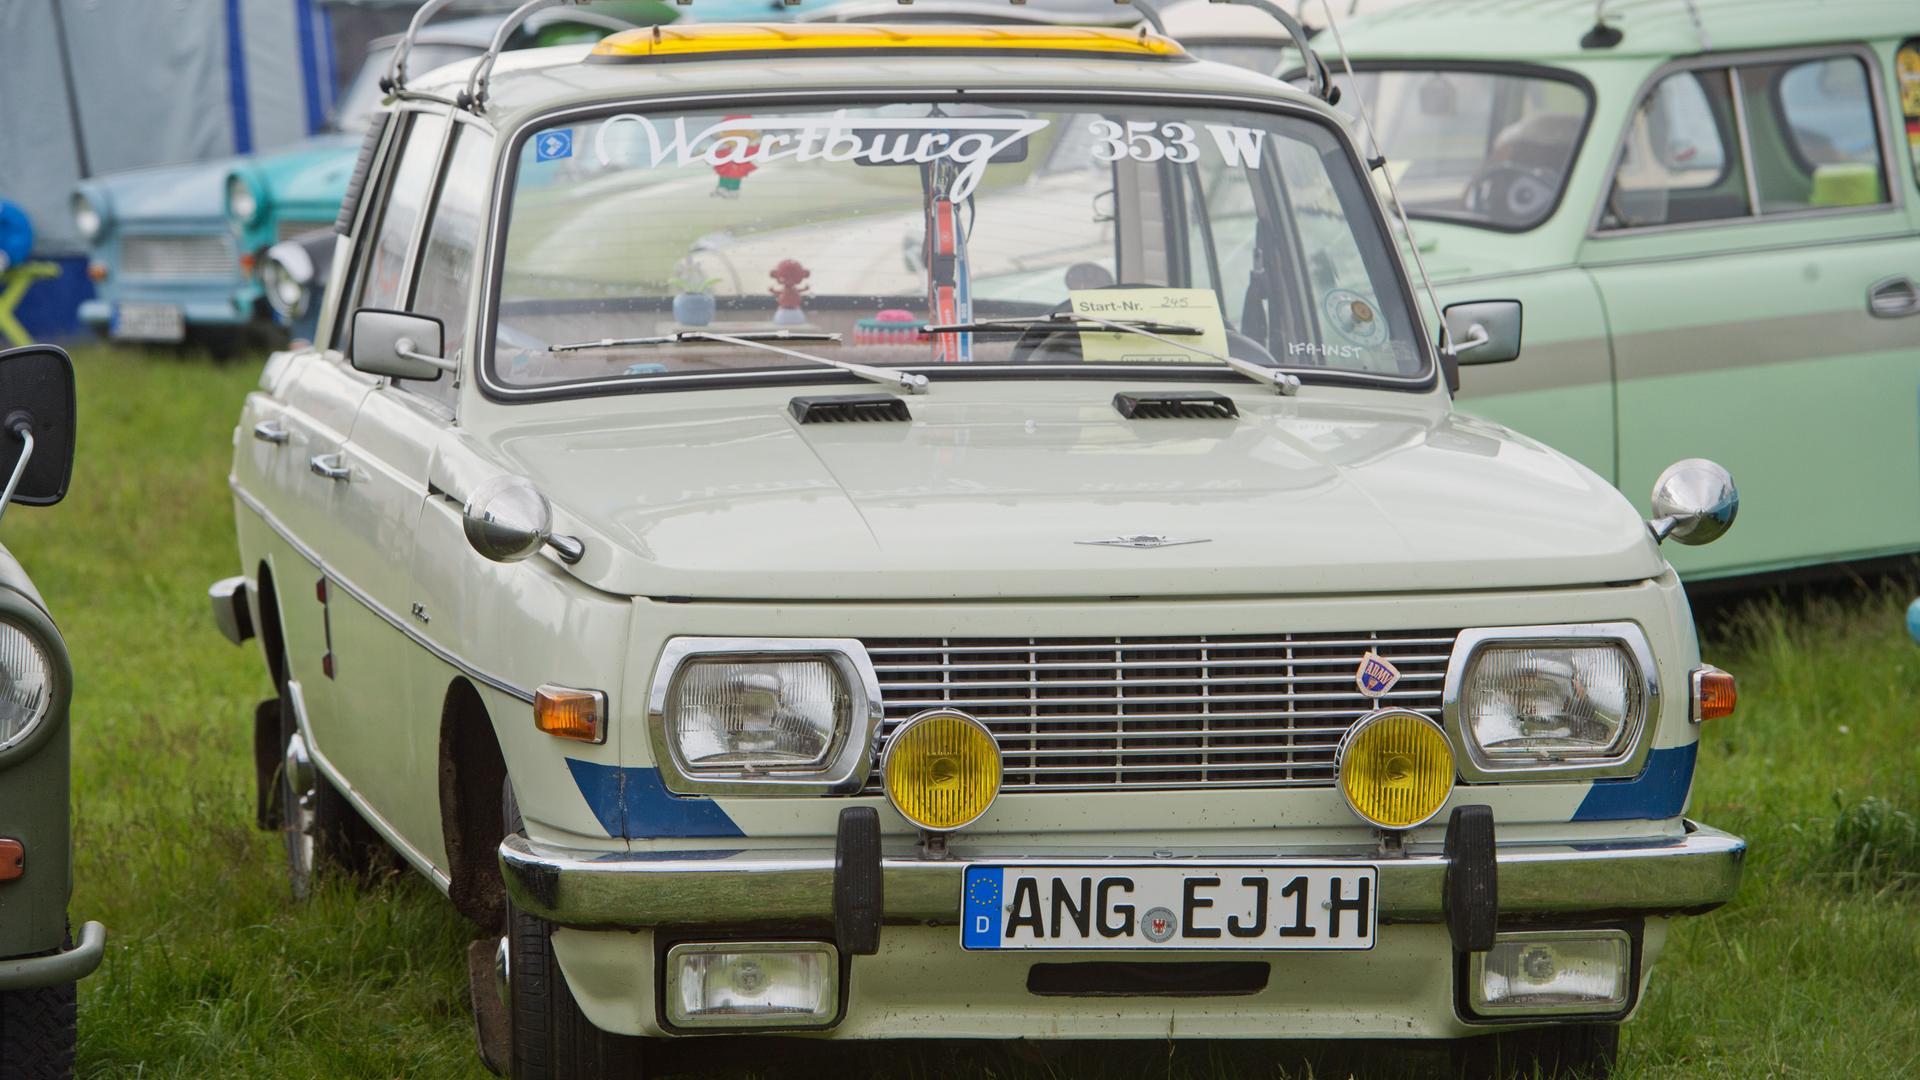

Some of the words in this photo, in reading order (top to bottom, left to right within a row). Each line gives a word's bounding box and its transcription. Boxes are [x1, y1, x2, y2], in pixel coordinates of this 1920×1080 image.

[595, 109, 1050, 203] Wartburg
[1087, 119, 1201, 164] 353
[1204, 123, 1267, 170] W
[1079, 301, 1144, 312] Start-Nr.
[975, 915, 991, 934] D
[1004, 876, 1136, 938] ANG
[1182, 876, 1370, 938] EJ1H
